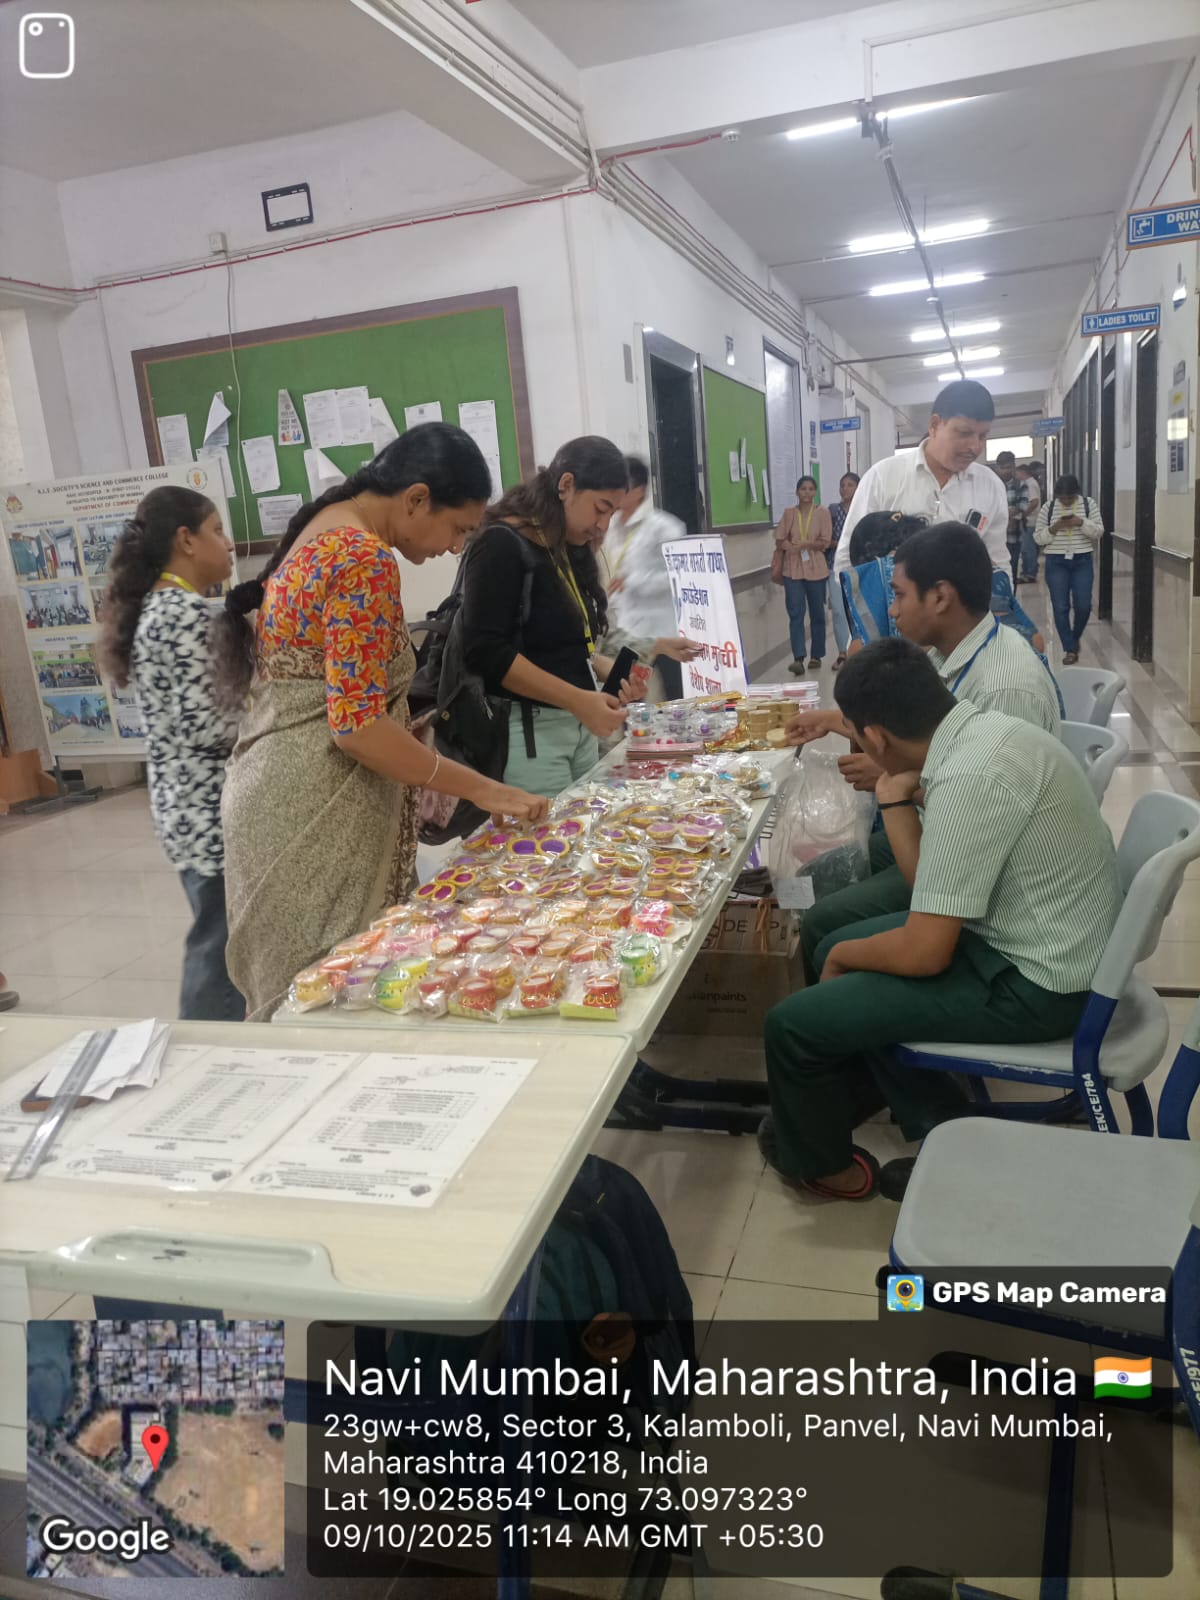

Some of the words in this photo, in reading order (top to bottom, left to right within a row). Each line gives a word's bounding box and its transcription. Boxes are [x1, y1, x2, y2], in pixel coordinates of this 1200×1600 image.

[1178, 219, 1200, 233] WA
[1098, 316, 1126, 328] LADIES
[1128, 311, 1156, 324] TOILET
[80, 480, 102, 490] SCIENCE
[102, 479, 114, 487] AND
[114, 475, 144, 486] COMMERCE
[145, 472, 169, 482] COLLEGE
[1081, 1072, 1110, 1134] EK/CE/784
